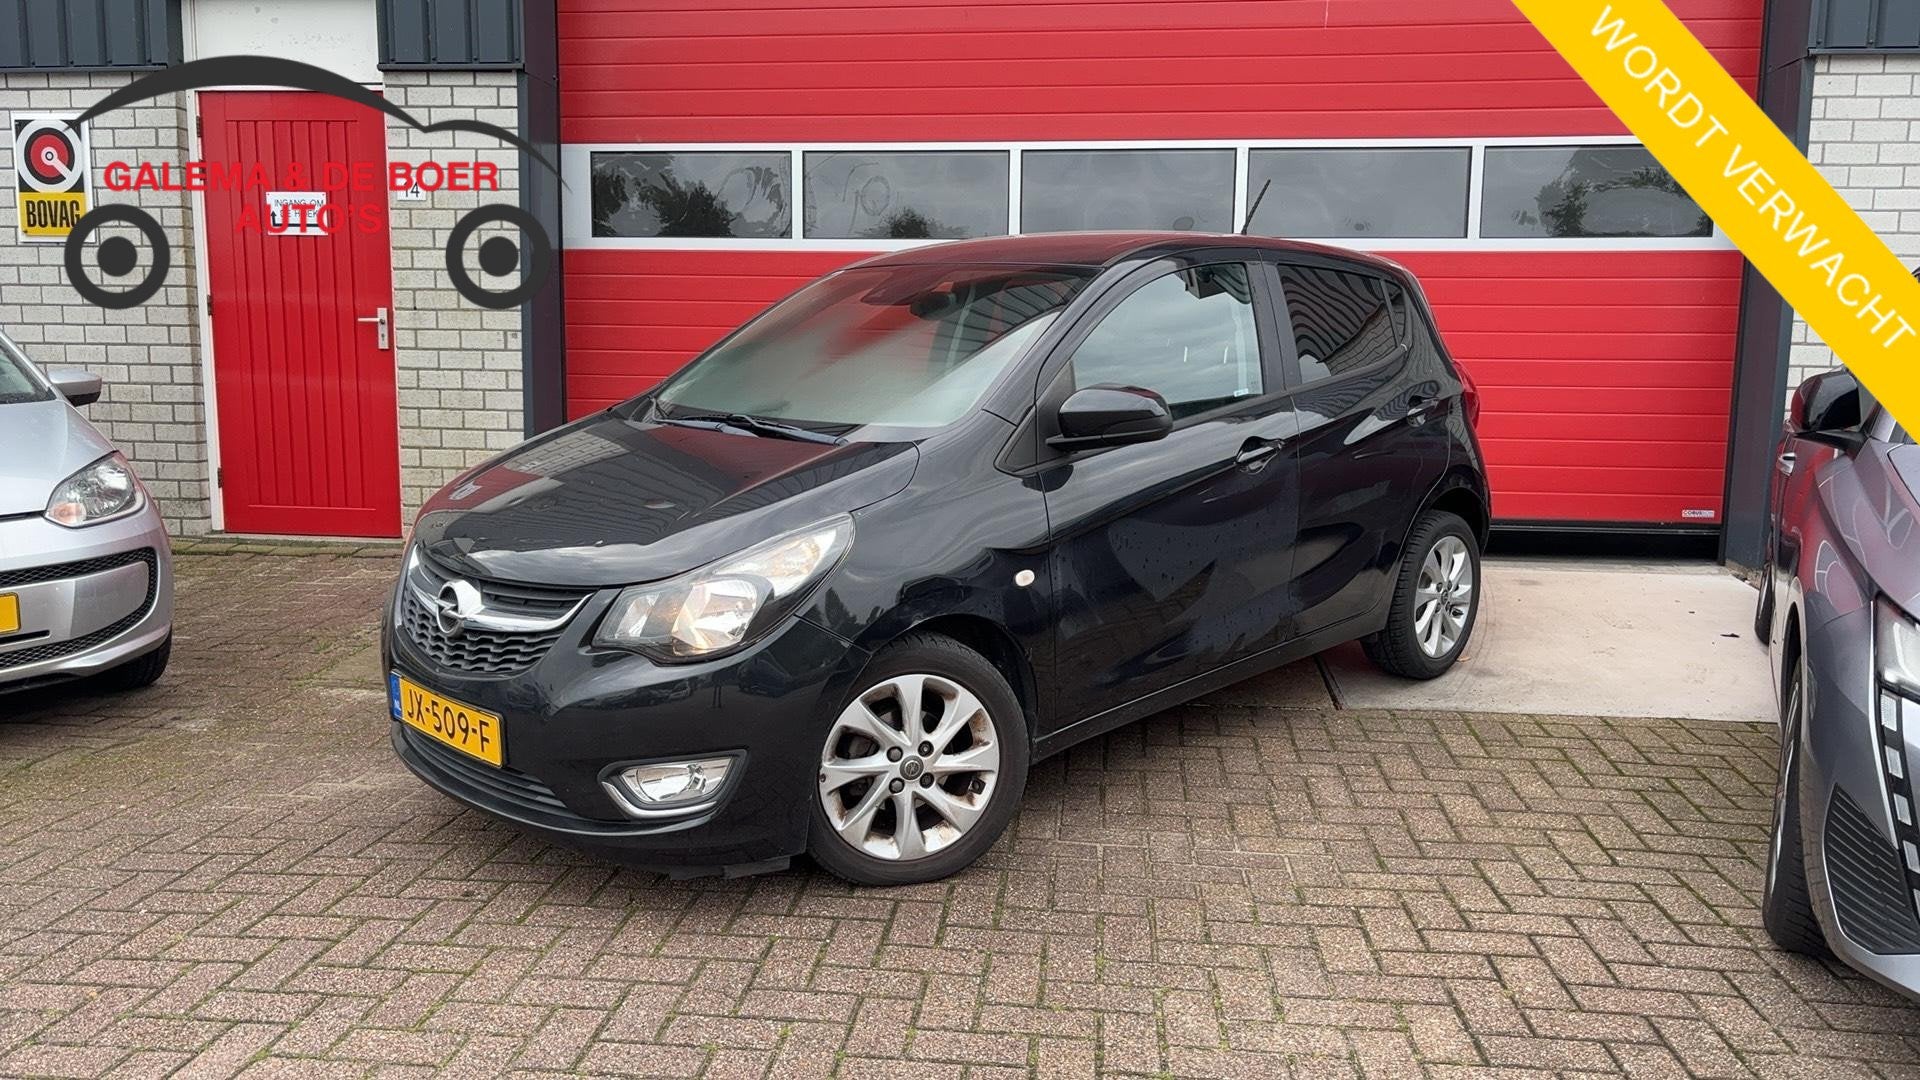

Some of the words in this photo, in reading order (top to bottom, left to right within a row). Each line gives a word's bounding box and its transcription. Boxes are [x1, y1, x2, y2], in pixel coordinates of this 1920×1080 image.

[309, 199, 324, 207] OM
[26, 200, 81, 228] BOVAG
[294, 209, 318, 218] HEK
[407, 689, 491, 753] JX-509-F
